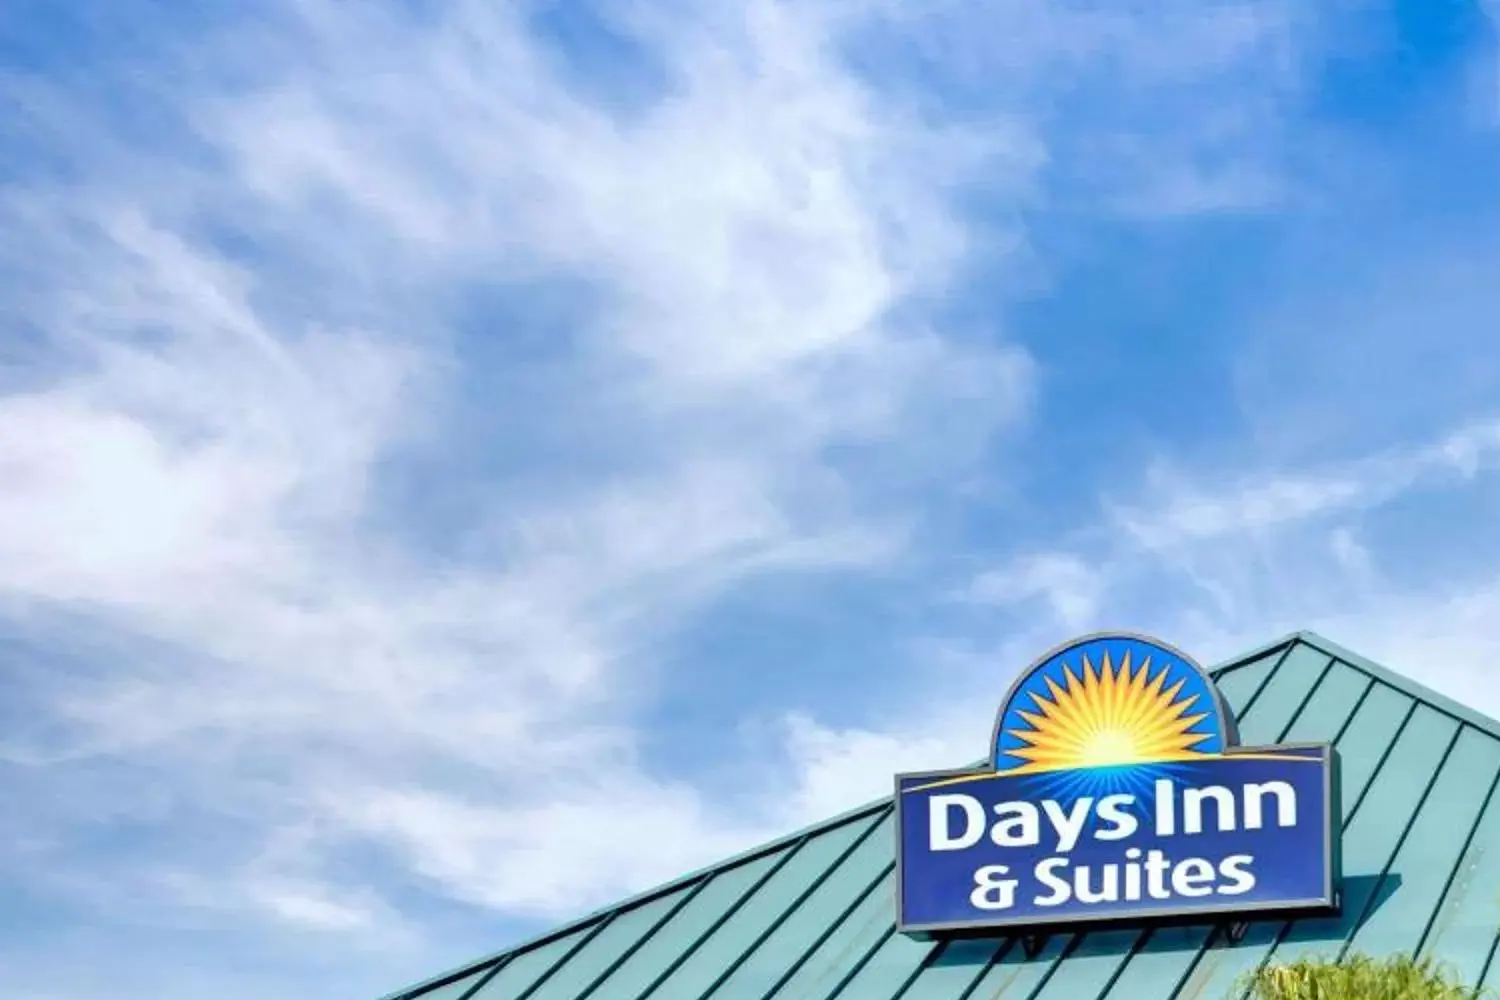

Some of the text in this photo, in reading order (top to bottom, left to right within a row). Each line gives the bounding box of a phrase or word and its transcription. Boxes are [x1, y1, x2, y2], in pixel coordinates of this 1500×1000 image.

[929, 779, 1297, 852] Days Inn
[970, 847, 1256, 910] & Suites
